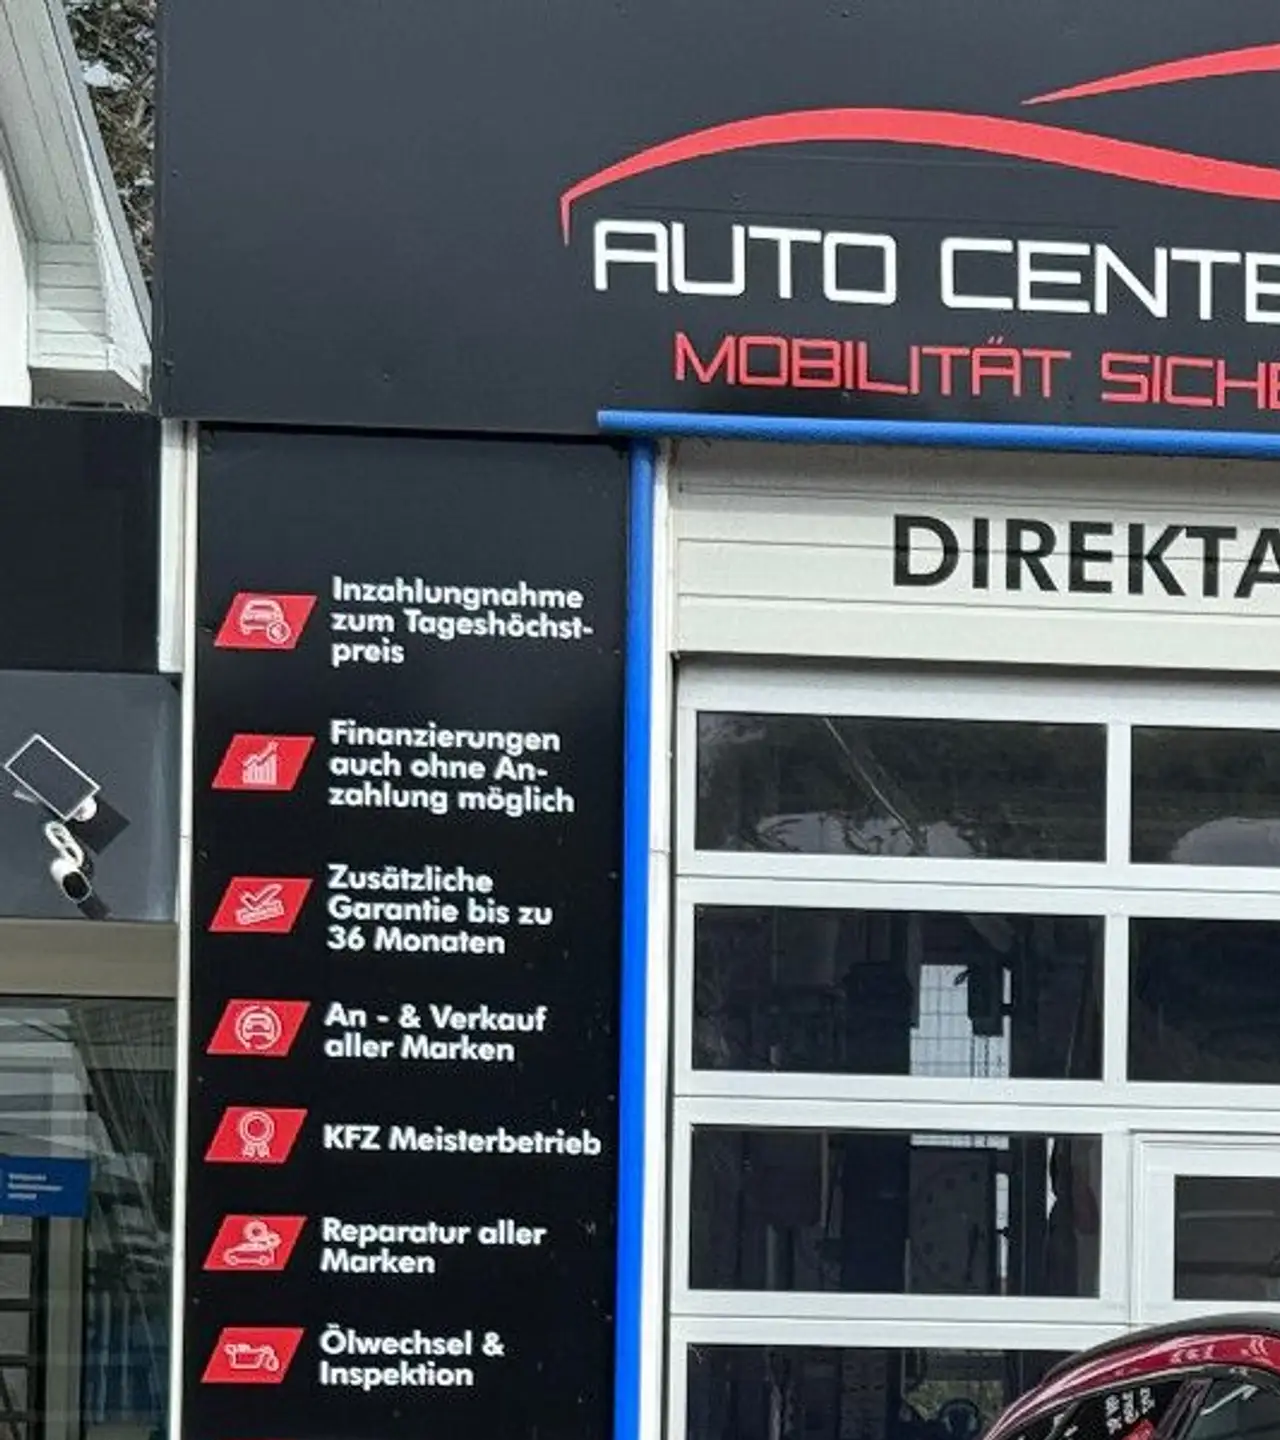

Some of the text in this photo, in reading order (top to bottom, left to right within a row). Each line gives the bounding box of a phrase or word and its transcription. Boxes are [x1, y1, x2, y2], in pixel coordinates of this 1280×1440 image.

[593, 219, 898, 306] AUTO
[675, 331, 1072, 398] MOBILITÄT
[333, 575, 584, 611] Inzahlungnahme
[331, 607, 594, 641] zum Tageshöchst-
[331, 637, 405, 668] preis
[330, 719, 561, 757] Finanzierungen
[329, 750, 548, 781] auch ohne An-
[328, 780, 575, 818] zahlung möglich
[328, 863, 494, 894] Zusätzliche
[327, 894, 553, 925] Garantie bis zu
[327, 924, 505, 954] 36 Monaten
[324, 1001, 367, 1028] An
[398, 1003, 421, 1029] &
[429, 1004, 548, 1032] Verkauf
[324, 1031, 515, 1062] aller Marken
[323, 1124, 602, 1156] KFZ Meisterbetrieb
[322, 1216, 547, 1249] Reparatur aller
[320, 1247, 436, 1274] Marken
[319, 1323, 505, 1357] Ölwechsel &
[320, 1360, 474, 1392] Inspektion
